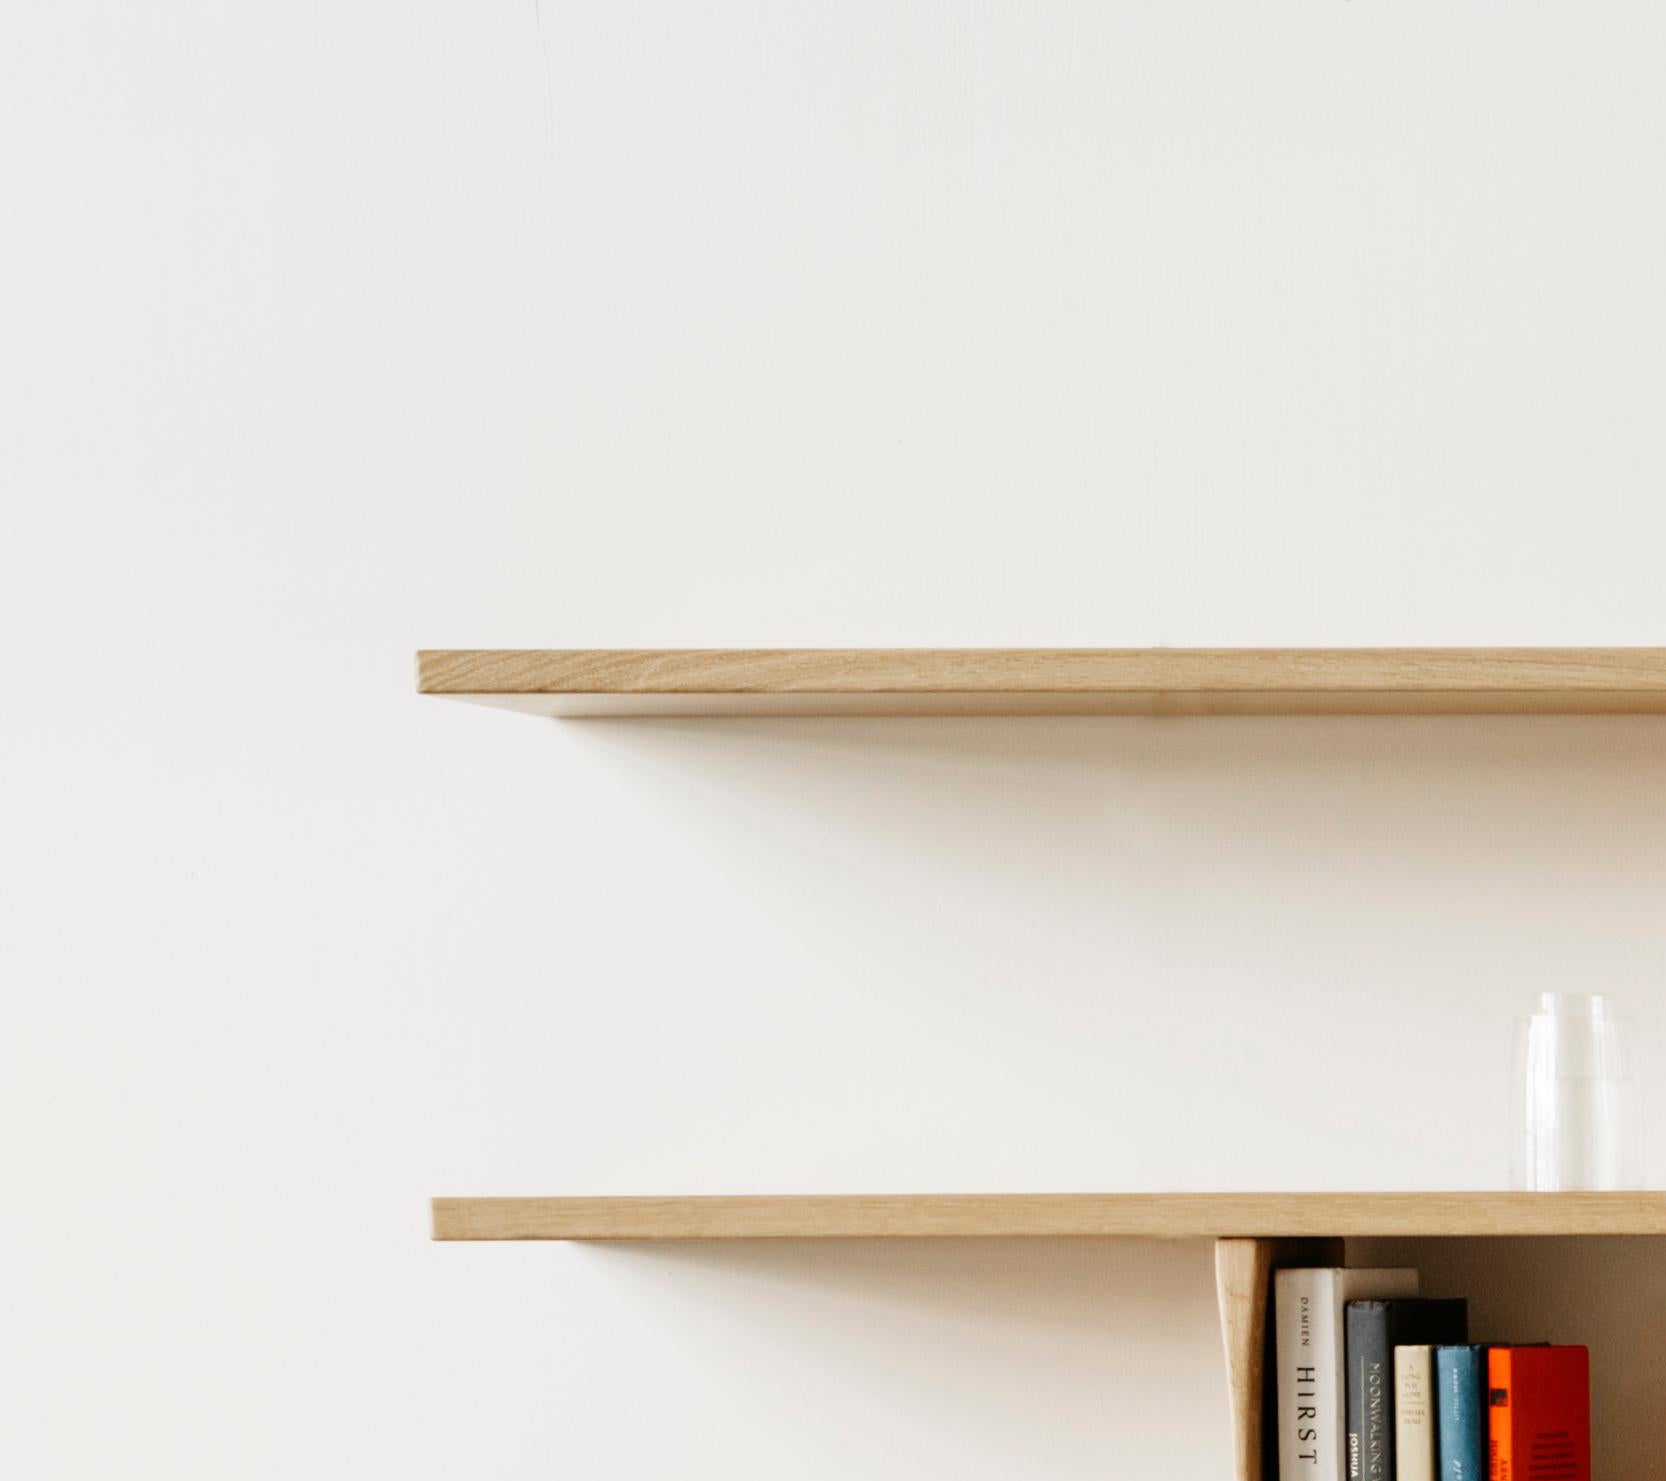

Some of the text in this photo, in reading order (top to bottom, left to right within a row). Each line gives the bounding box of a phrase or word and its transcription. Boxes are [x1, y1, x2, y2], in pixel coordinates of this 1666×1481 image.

[1297, 1297, 1318, 1465] DAMIEN HIRST
[1369, 1362, 1383, 1474] MOONWALKING
[1349, 1432, 1360, 1477] JOSHUA
